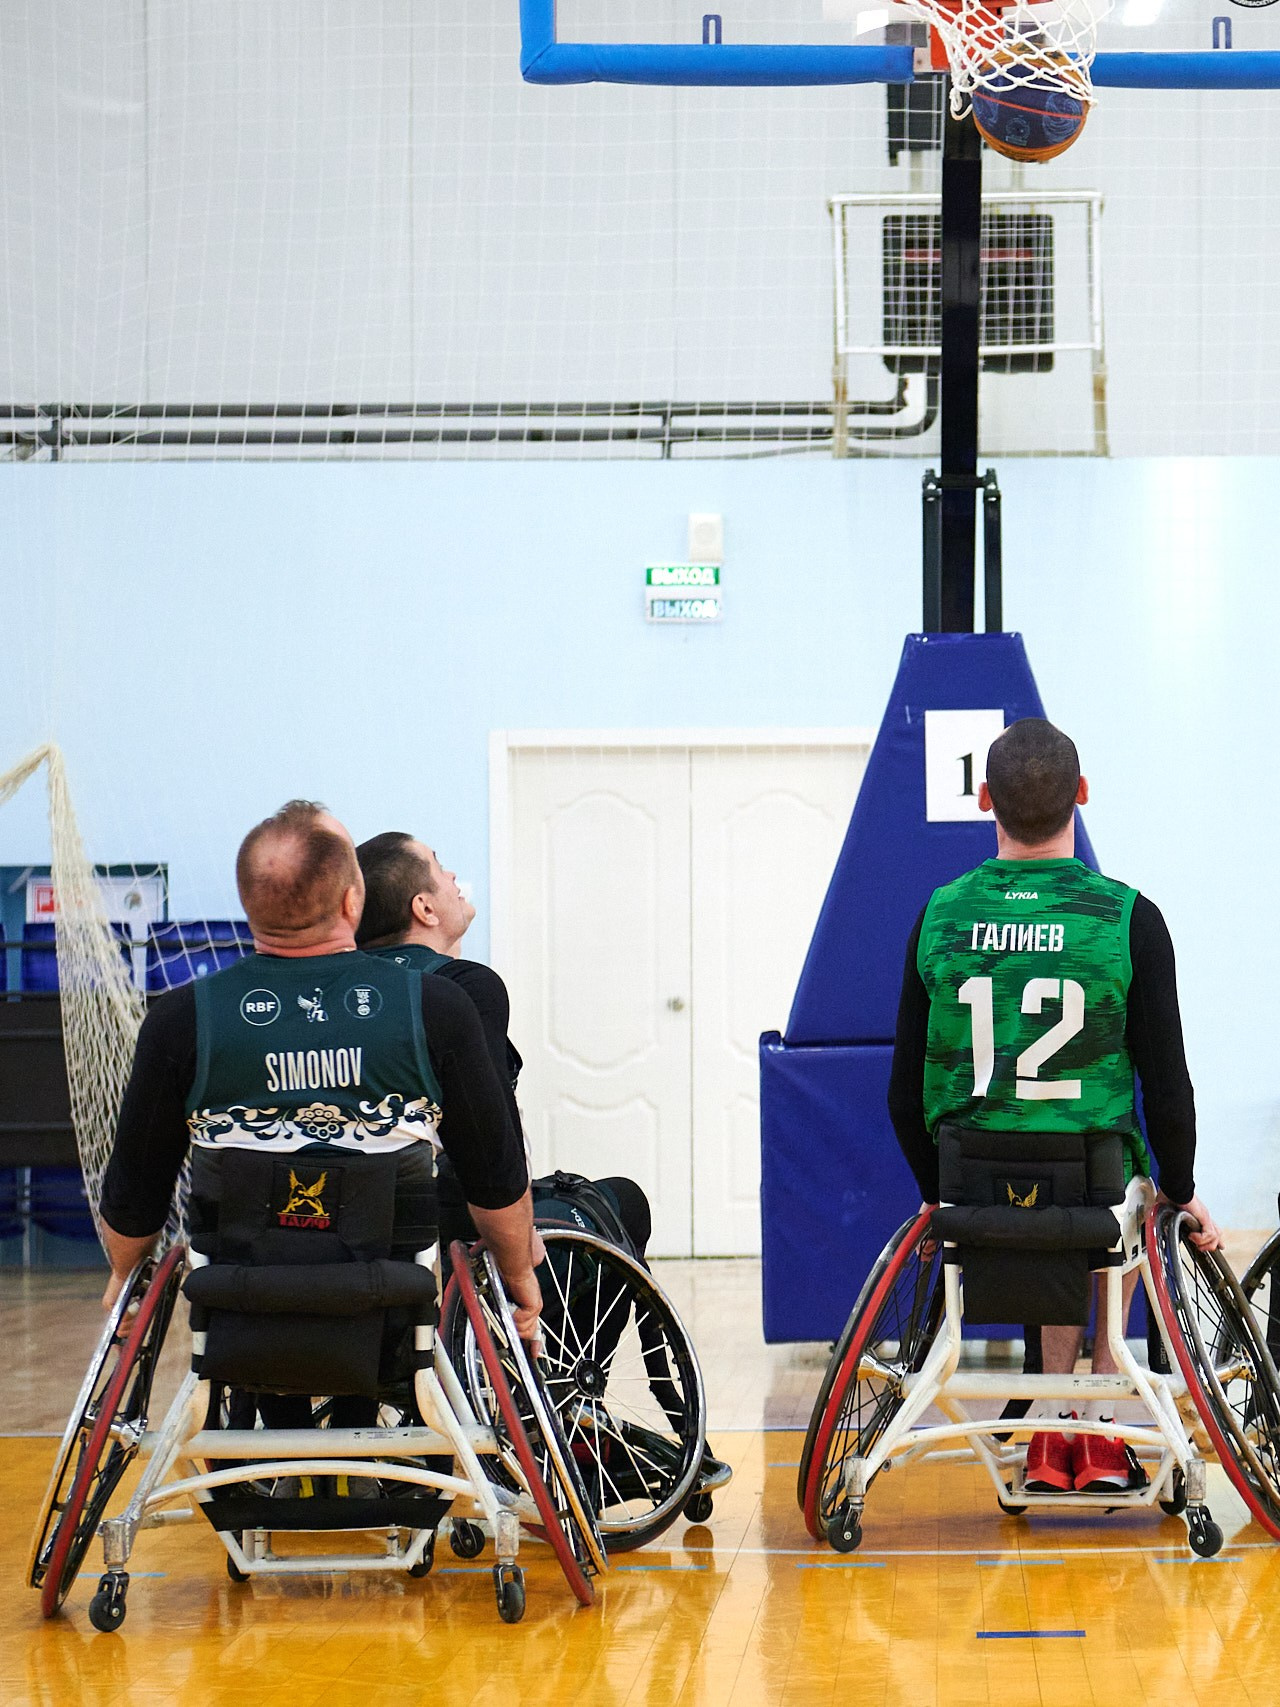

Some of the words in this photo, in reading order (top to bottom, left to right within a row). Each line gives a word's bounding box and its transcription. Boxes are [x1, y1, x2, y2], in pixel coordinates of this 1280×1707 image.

[653, 600, 718, 617] ВЫХОД
[956, 752, 978, 796] 1
[1005, 891, 1039, 900] LYKIA
[971, 922, 1065, 952] ГАЛИЕВ
[246, 1001, 276, 1014] RBF
[958, 976, 1085, 1100] 12
[265, 1047, 362, 1092] SIMONOV
